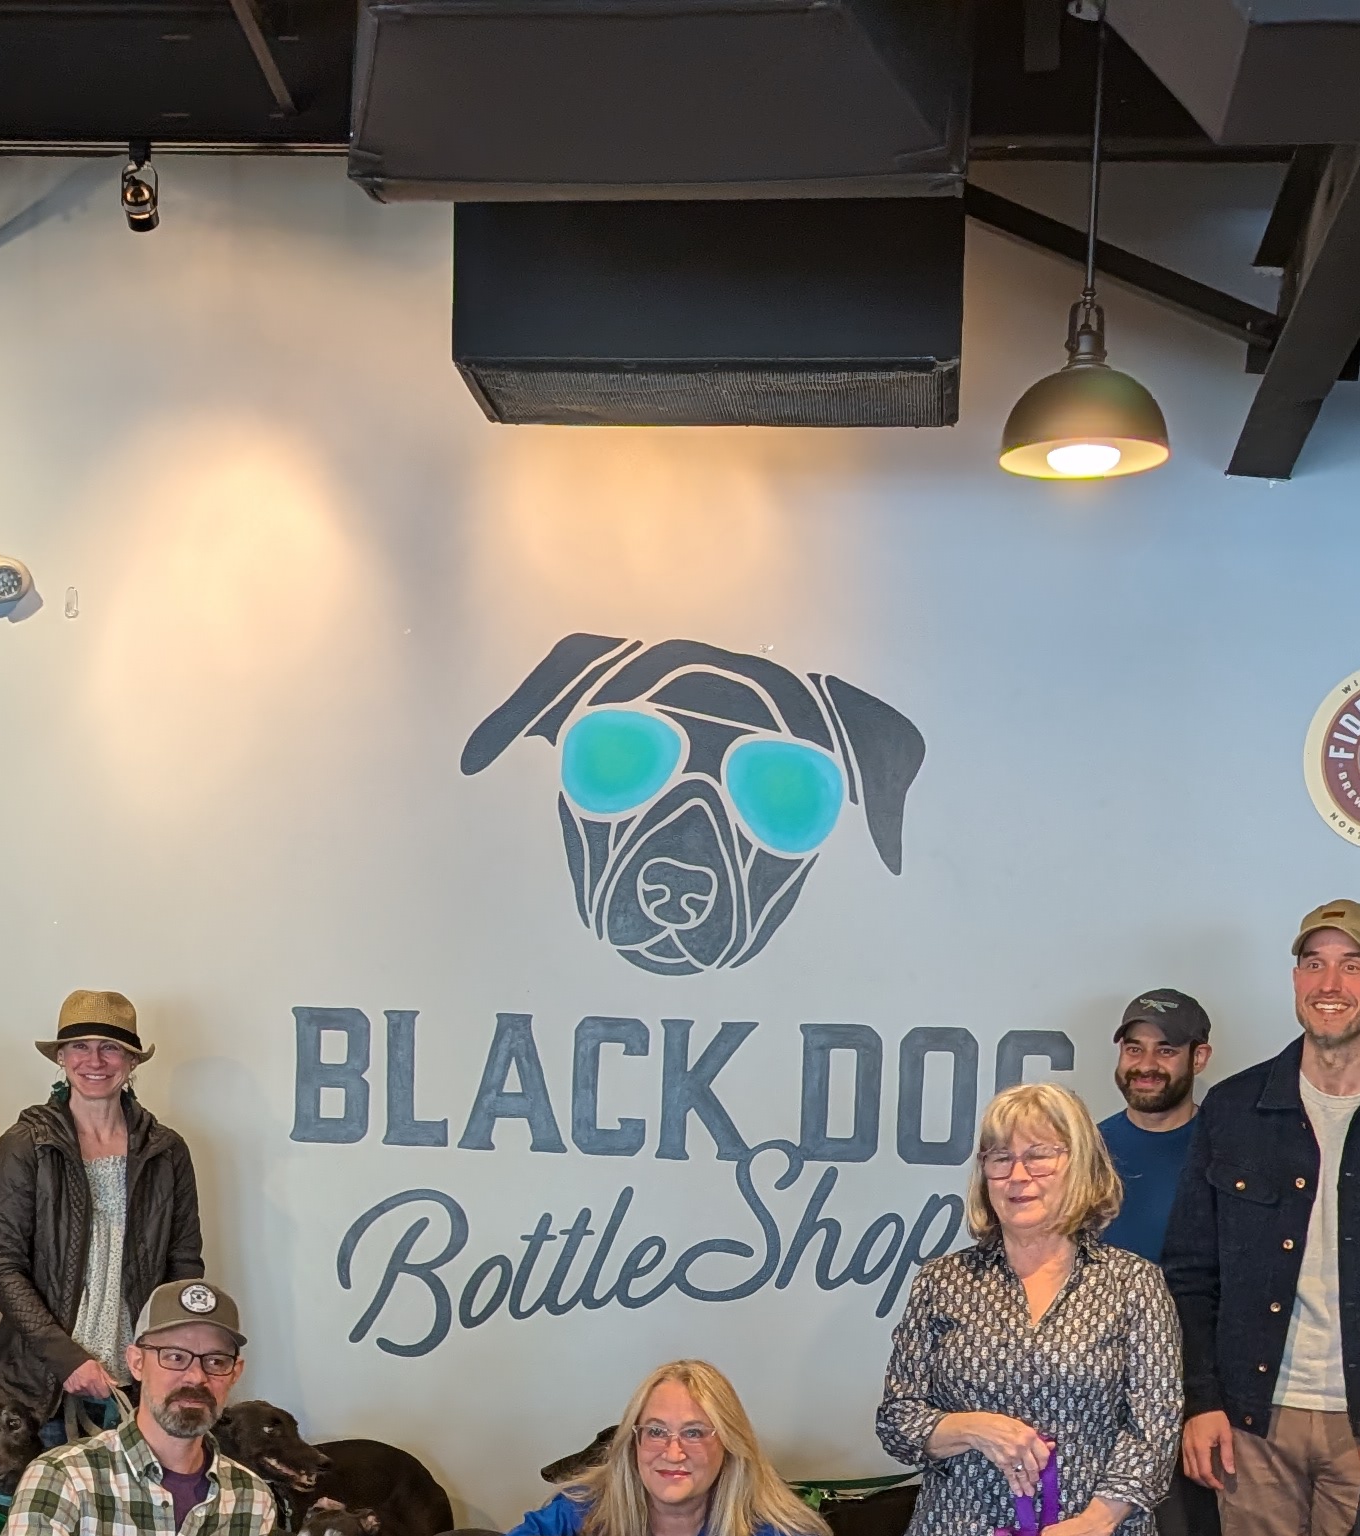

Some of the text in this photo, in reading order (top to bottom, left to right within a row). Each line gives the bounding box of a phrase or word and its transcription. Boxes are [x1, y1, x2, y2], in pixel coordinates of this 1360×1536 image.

[289, 1006, 761, 1162] BLACK
[337, 1138, 962, 1358] Bottle Shop
